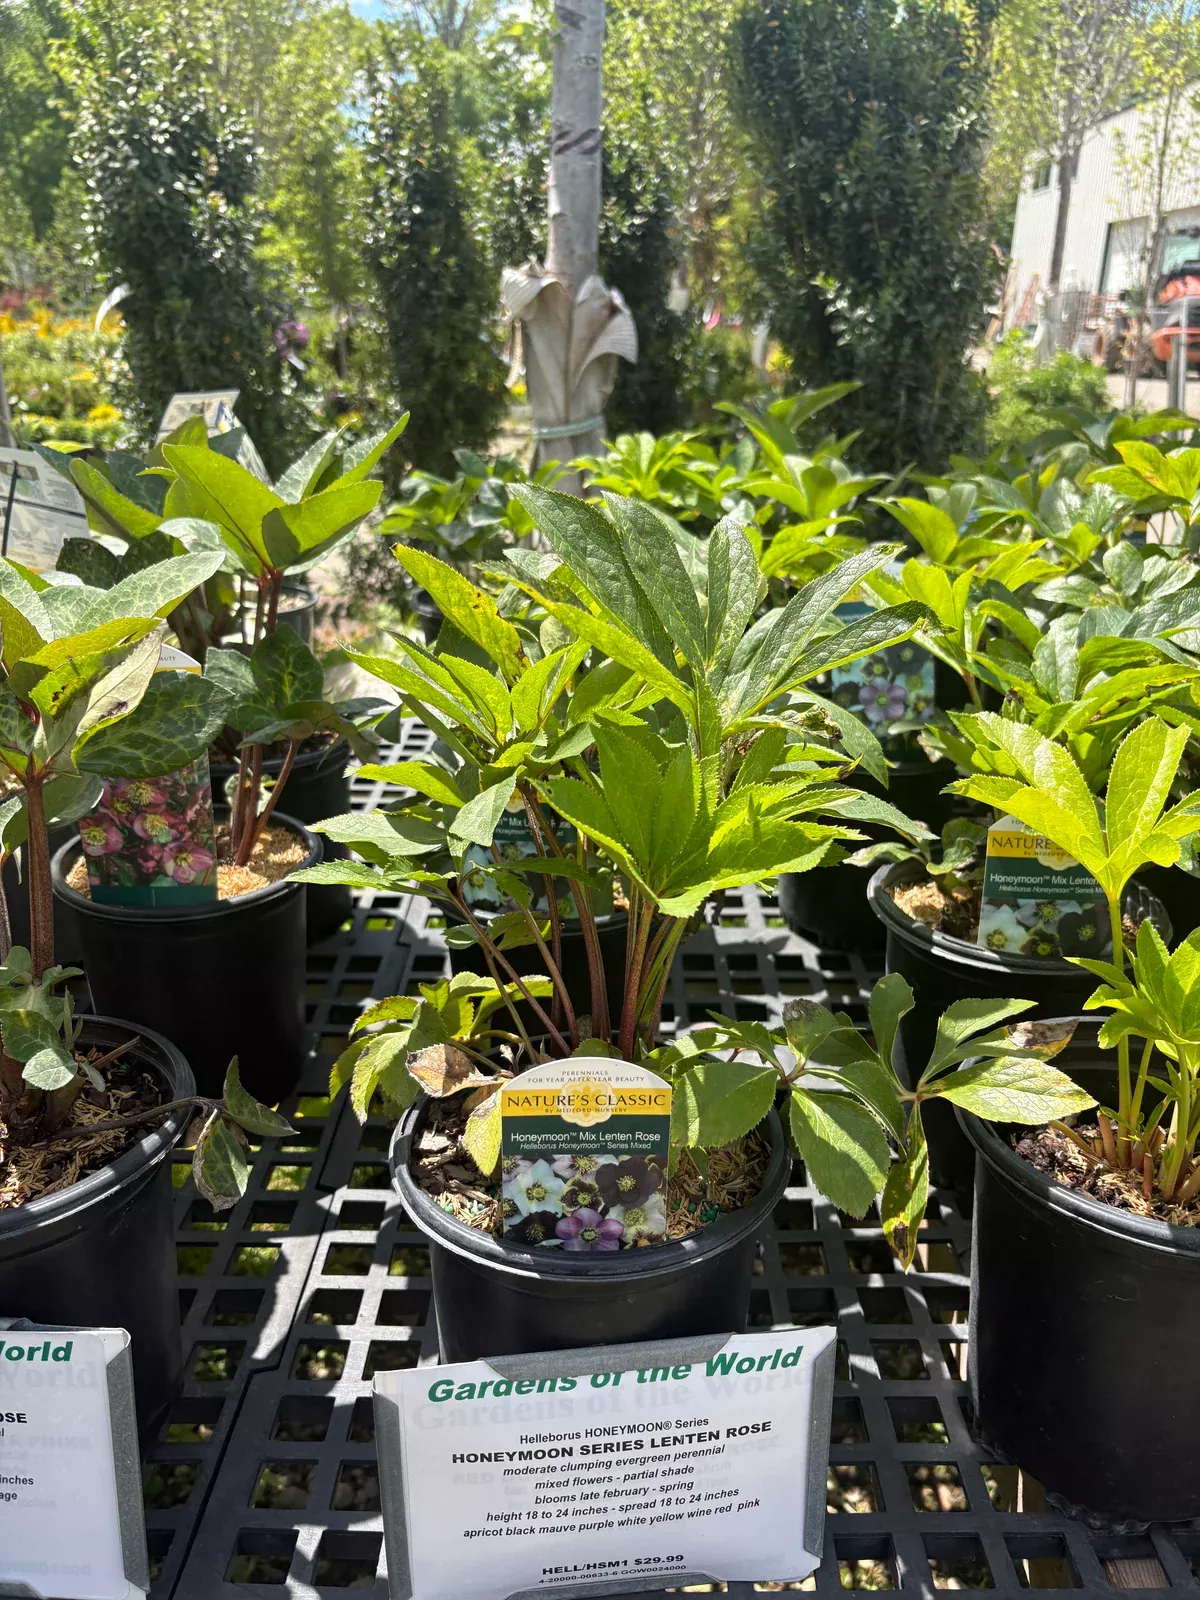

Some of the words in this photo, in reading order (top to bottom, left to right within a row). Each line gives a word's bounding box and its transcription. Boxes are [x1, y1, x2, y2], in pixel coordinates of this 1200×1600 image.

[1052, 875, 1067, 884] Mix
[507, 1095, 590, 1107] NATURE'S
[595, 1094, 666, 1106] CLASSIC
[520, 1142, 557, 1150] Helleborus
[579, 1132, 597, 1141] Mix
[599, 1132, 633, 1141] Lenten
[635, 1132, 661, 1141] Rose
[705, 1345, 804, 1377] World
[452, 1447, 574, 1464] HONEYMOON
[579, 1439, 645, 1456] SERIES
[650, 1430, 720, 1449] LENTEN
[726, 1421, 772, 1439] ROSE
[520, 1431, 581, 1445] Helleborus
[675, 1417, 709, 1429] Series
[503, 1465, 557, 1476] moderate
[560, 1459, 613, 1472] clumping
[615, 1453, 671, 1468] evergreen
[673, 1444, 726, 1462] perennial
[534, 1478, 570, 1490] mixed
[572, 1474, 613, 1487] flowers
[622, 1468, 659, 1484] partial
[661, 1465, 695, 1477] shade
[486, 1511, 523, 1523] height
[525, 1510, 538, 1520] 18
[541, 1510, 553, 1519] to
[555, 1508, 569, 1518] 24
[571, 1504, 609, 1517] inches
[618, 1499, 656, 1514] spread
[659, 1498, 672, 1508] 18
[675, 1496, 686, 1506] to
[689, 1493, 702, 1504] 24
[704, 1487, 740, 1501] inches
[534, 1492, 577, 1505] blooms
[579, 1490, 600, 1501] late
[603, 1485, 650, 1499] february
[659, 1480, 695, 1493] spring
[463, 1527, 503, 1539] apricot
[505, 1525, 536, 1536] black
[538, 1524, 576, 1534] mauve
[578, 1518, 615, 1533] purple
[617, 1515, 647, 1527] white
[649, 1512, 685, 1526] yellow
[687, 1508, 712, 1519] wine
[714, 1503, 733, 1515] red
[736, 1497, 761, 1513] pink
[542, 1559, 628, 1576] HELL/HSM1
[634, 1554, 685, 1566] $29.99
